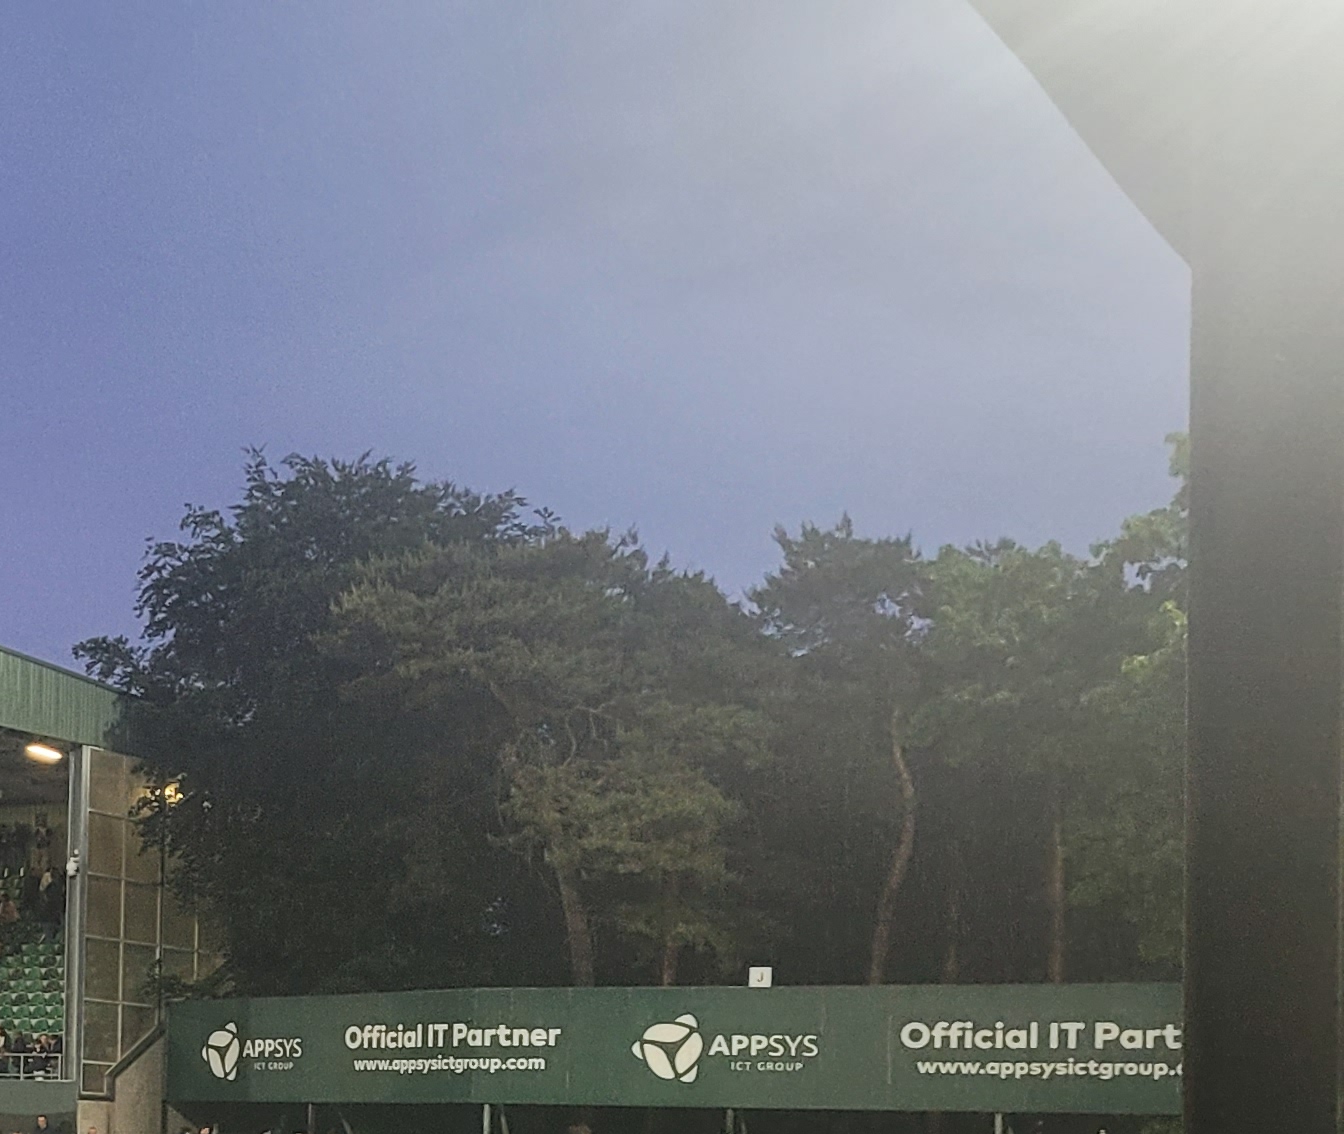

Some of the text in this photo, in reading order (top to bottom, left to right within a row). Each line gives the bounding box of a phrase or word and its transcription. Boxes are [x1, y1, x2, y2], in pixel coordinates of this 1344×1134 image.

[344, 1024, 562, 1050] Official IT Partner
[708, 1034, 819, 1057] APPSYS
[900, 1021, 1038, 1049] Official
[1049, 1022, 1085, 1049] IT
[242, 1038, 303, 1059] APPSYS
[268, 1061, 294, 1071] GROUP
[353, 1055, 546, 1075] www.appsysictgroup.com
[730, 1061, 804, 1071] ICT GROUP
